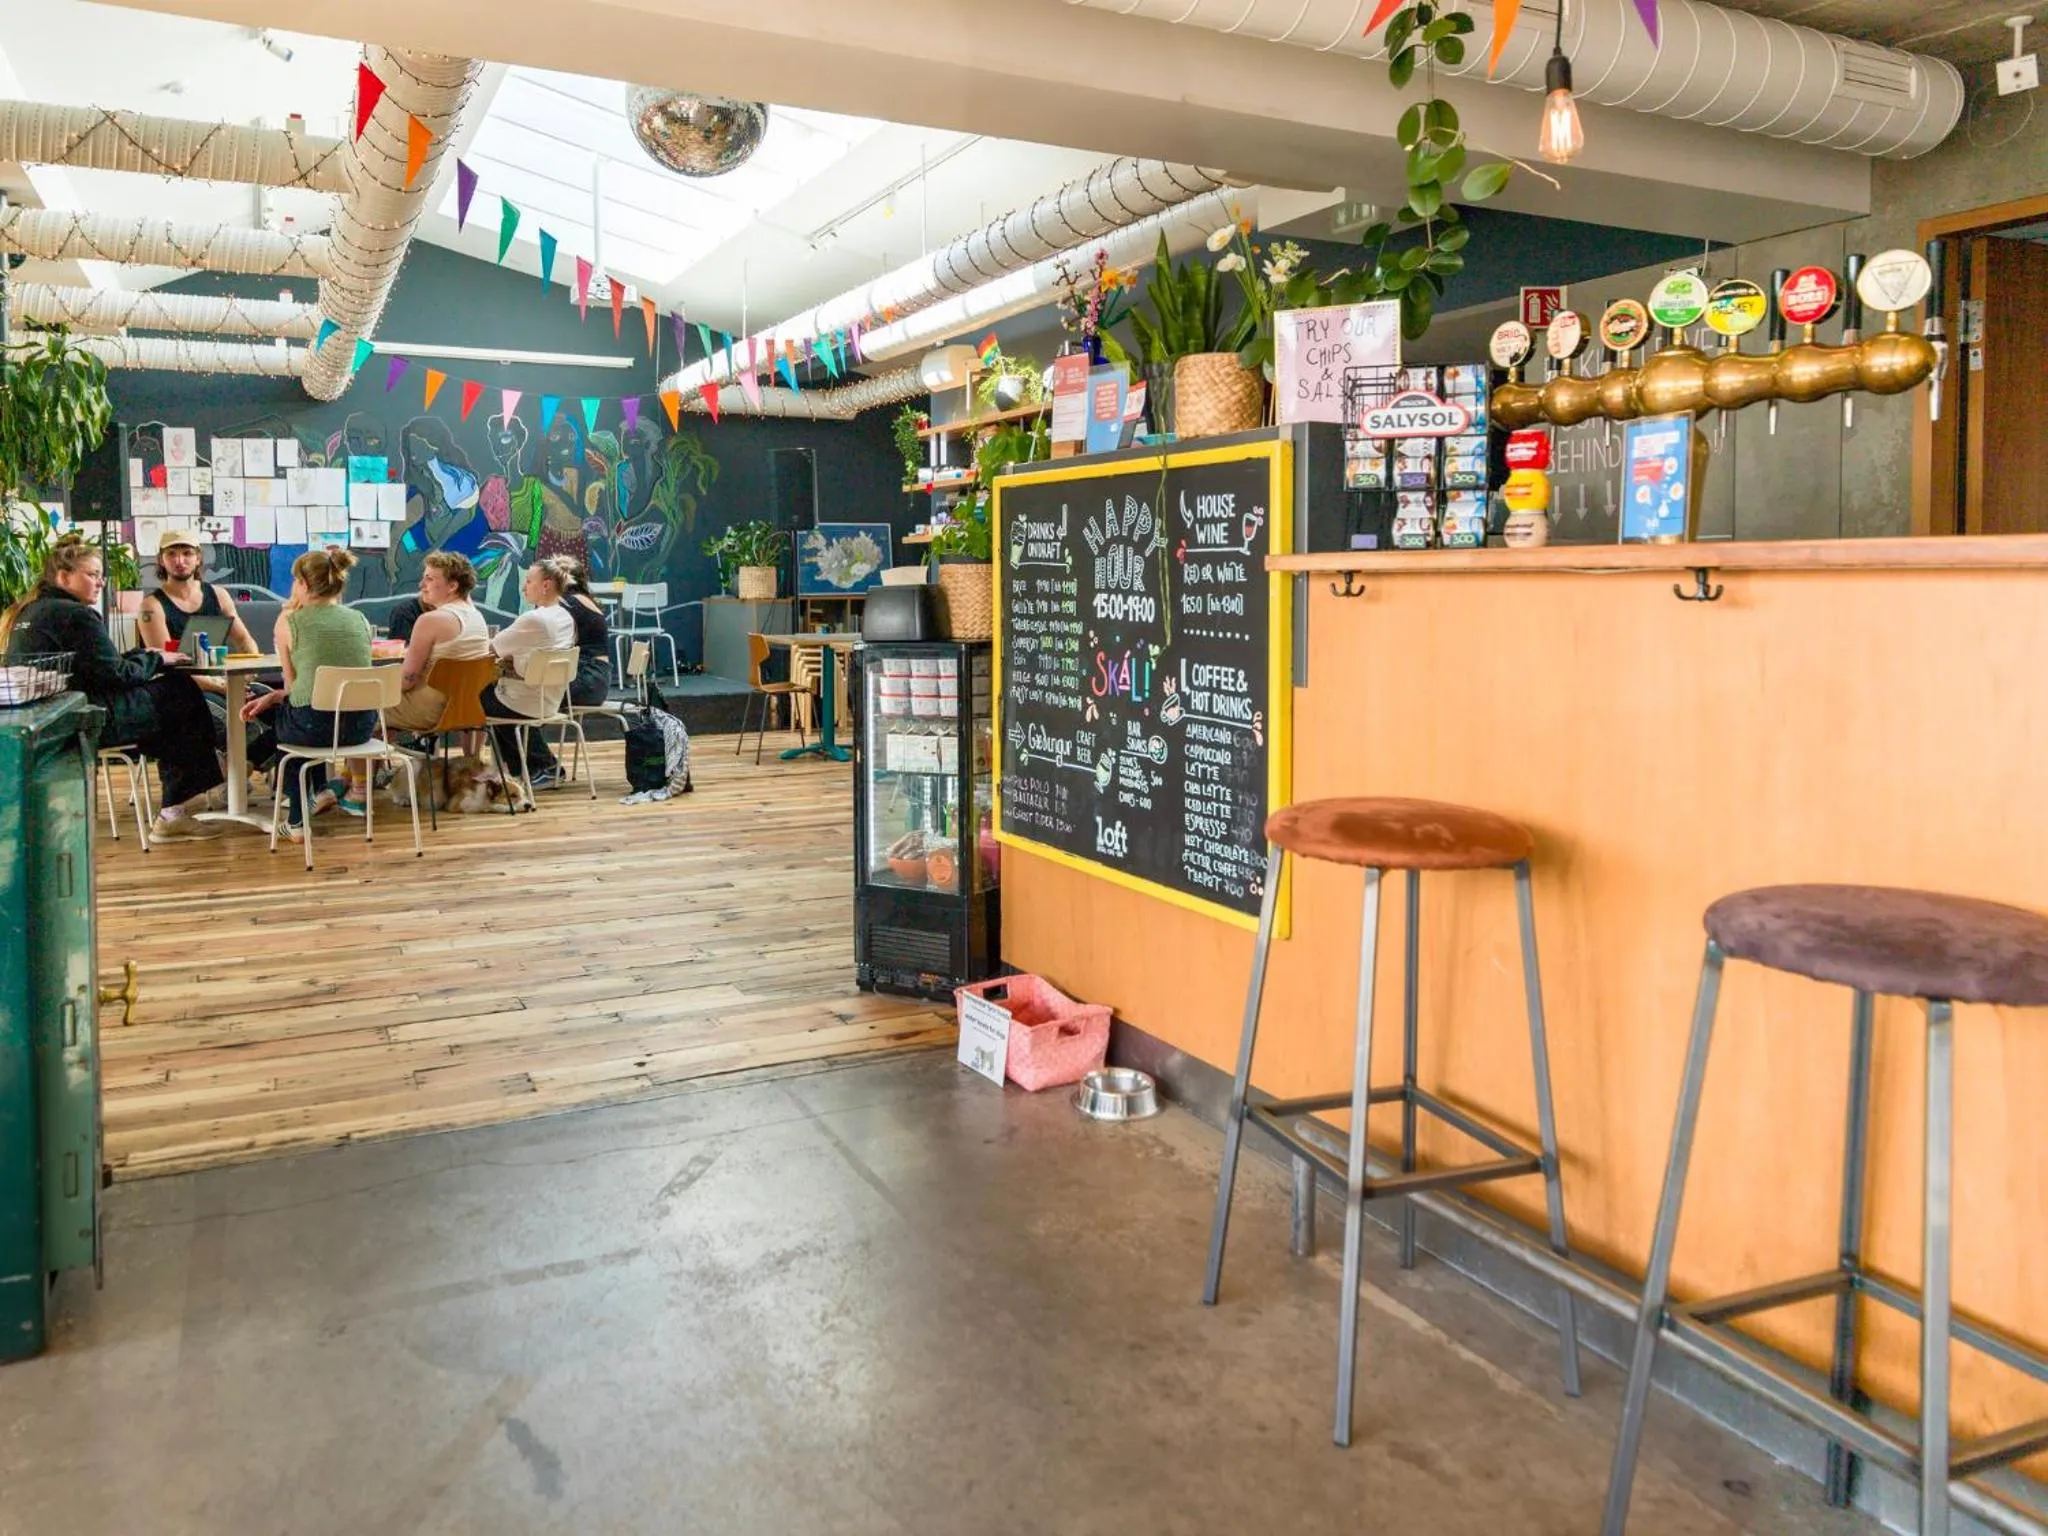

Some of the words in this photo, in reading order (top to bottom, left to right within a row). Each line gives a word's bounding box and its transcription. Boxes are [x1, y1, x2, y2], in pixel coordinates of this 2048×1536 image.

[1290, 318, 1330, 343] TRY
[1340, 316, 1376, 338] OUR
[1306, 342, 1352, 368] CHIPS
[1321, 368, 1334, 381] &
[1370, 412, 1459, 429] SALYSOL
[1196, 493, 1236, 518] HOUSE
[1028, 522, 1055, 540] DRINKS
[1082, 494, 1168, 558] HAPPY
[1196, 523, 1229, 544] WINE
[1094, 544, 1145, 592] HOUR
[1184, 563, 1200, 585] RED
[1217, 562, 1248, 584] WHITE
[1092, 650, 1149, 702] SKÁL!
[1191, 690, 1211, 713] HOT
[1212, 693, 1253, 720] DRINKS
[1076, 730, 1097, 748] CRAFT
[1186, 723, 1233, 745] AMERICANO
[1185, 761, 1221, 781] LATTE
[1202, 783, 1233, 802] LATTE
[1202, 801, 1233, 819] LATTE
[1095, 816, 1128, 854] loft
[1185, 813, 1229, 840] ESPRESSO
[1185, 833, 1203, 849] HOT
[1204, 840, 1249, 864] CHOCOLATE
[1183, 865, 1223, 892] TEAPOT
